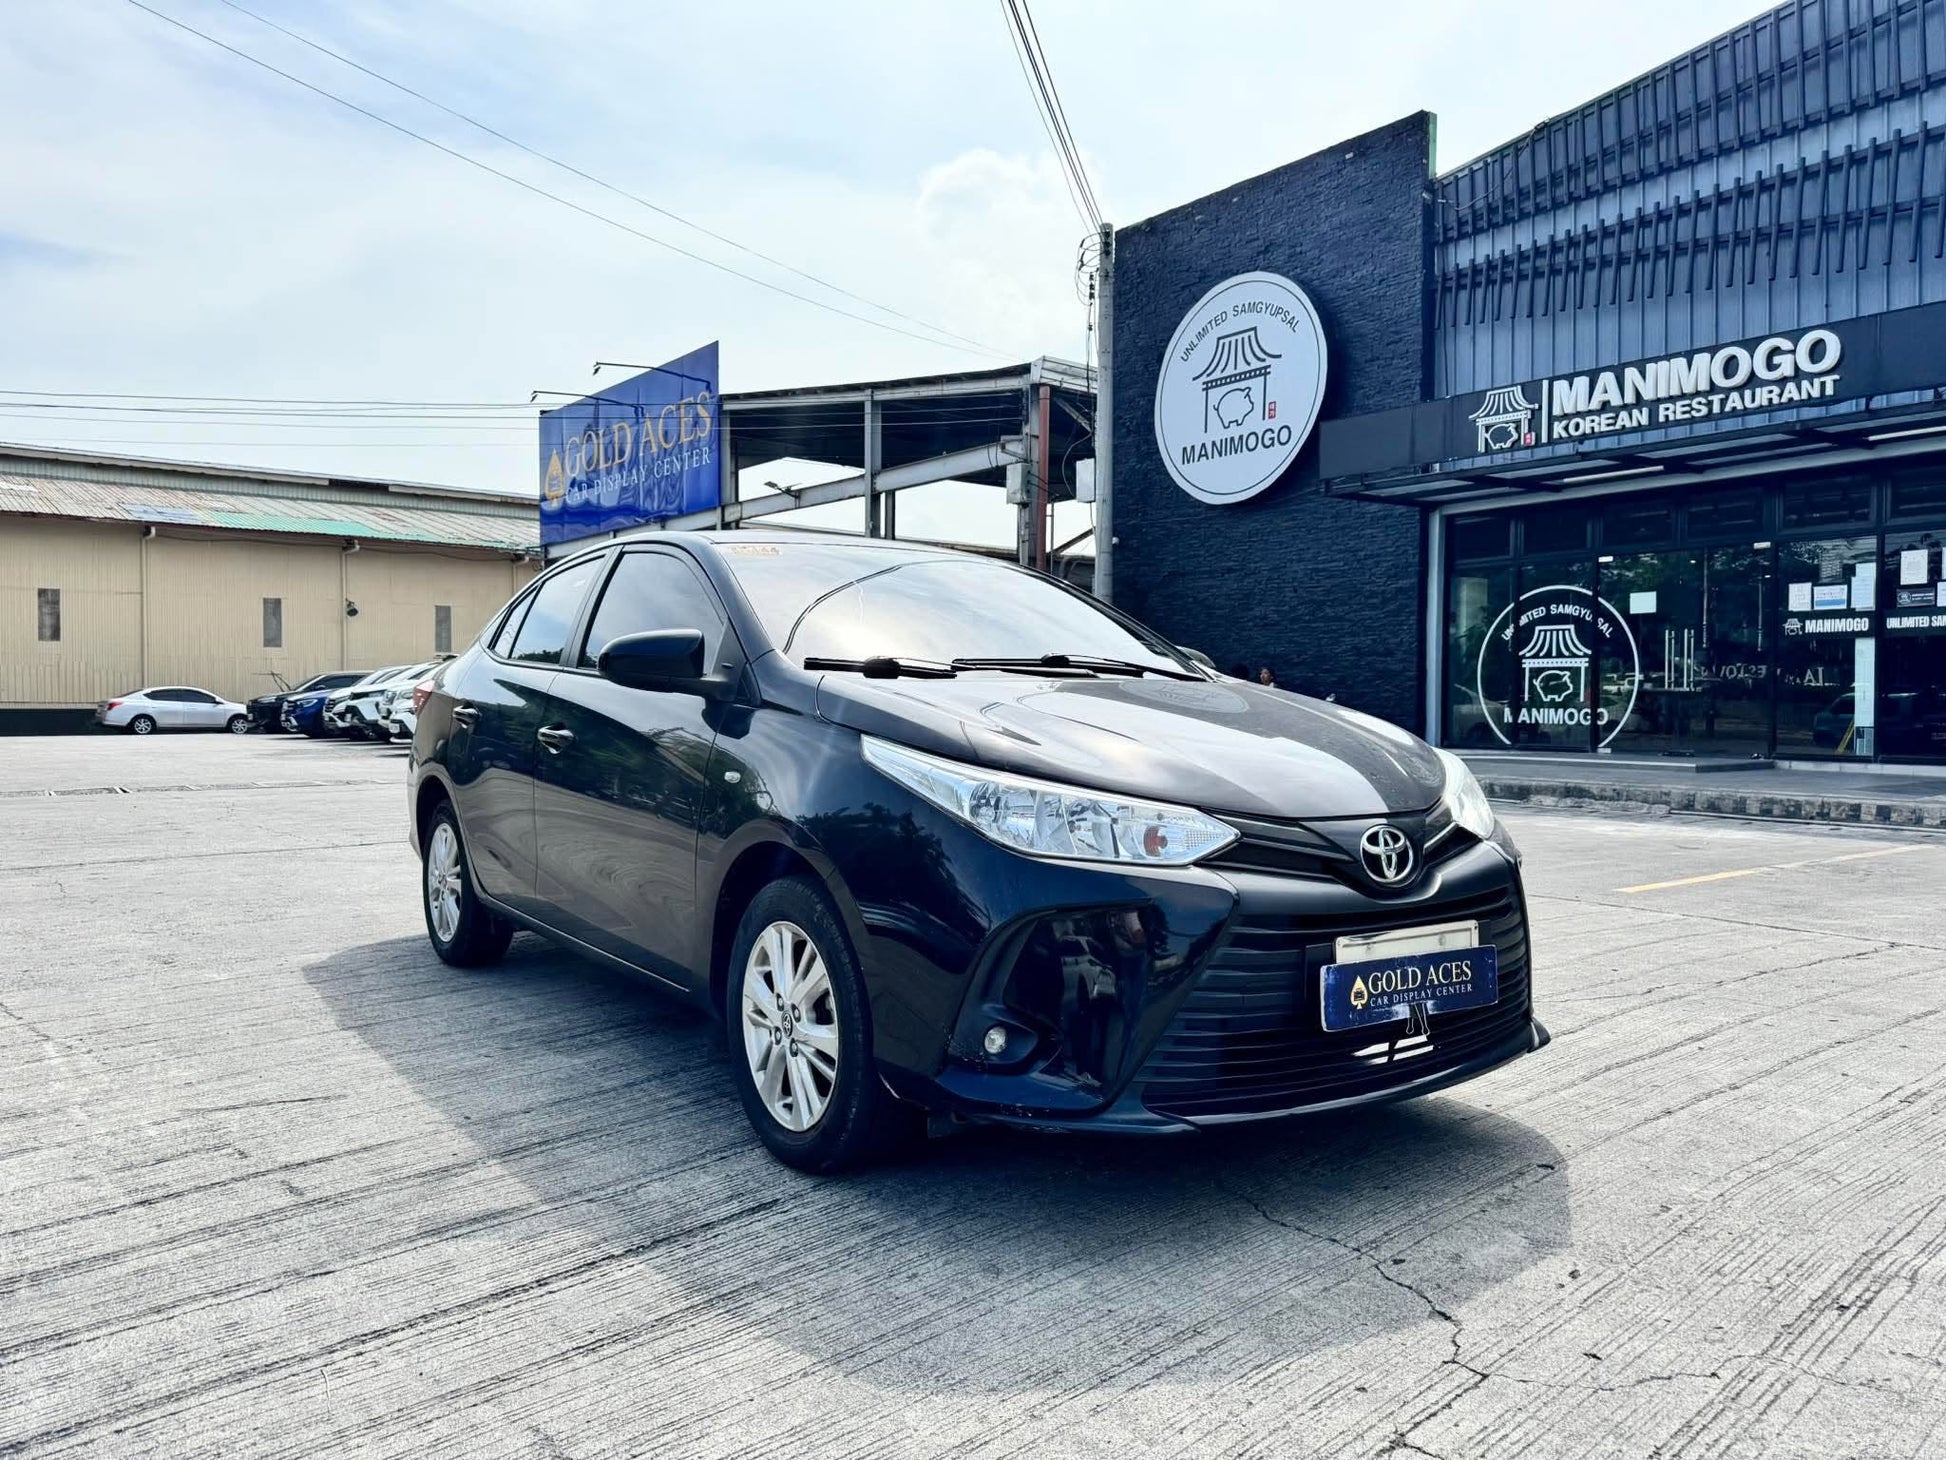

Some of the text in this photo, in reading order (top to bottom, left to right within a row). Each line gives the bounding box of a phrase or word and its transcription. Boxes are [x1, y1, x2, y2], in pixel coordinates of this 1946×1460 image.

[1180, 301, 1300, 362] UNLIMITED SAMGYUPSAL
[1552, 330, 1841, 416] MANIMOGO
[1553, 374, 1840, 439] KOREAN RESTAURANT
[564, 391, 712, 477] GOLD ACES
[1182, 425, 1292, 465] MANIMOGO
[565, 446, 711, 502] CAR DISPLAY CENTER
[1501, 604, 1613, 640] UNMITED SAMGYUSAL
[1804, 617, 1869, 633] MANIMOGO
[1886, 615, 1930, 629] UNLIMITED
[1368, 960, 1472, 994] GOLD ACES
[1370, 983, 1473, 1007] CAR DISPLAY CENTER
